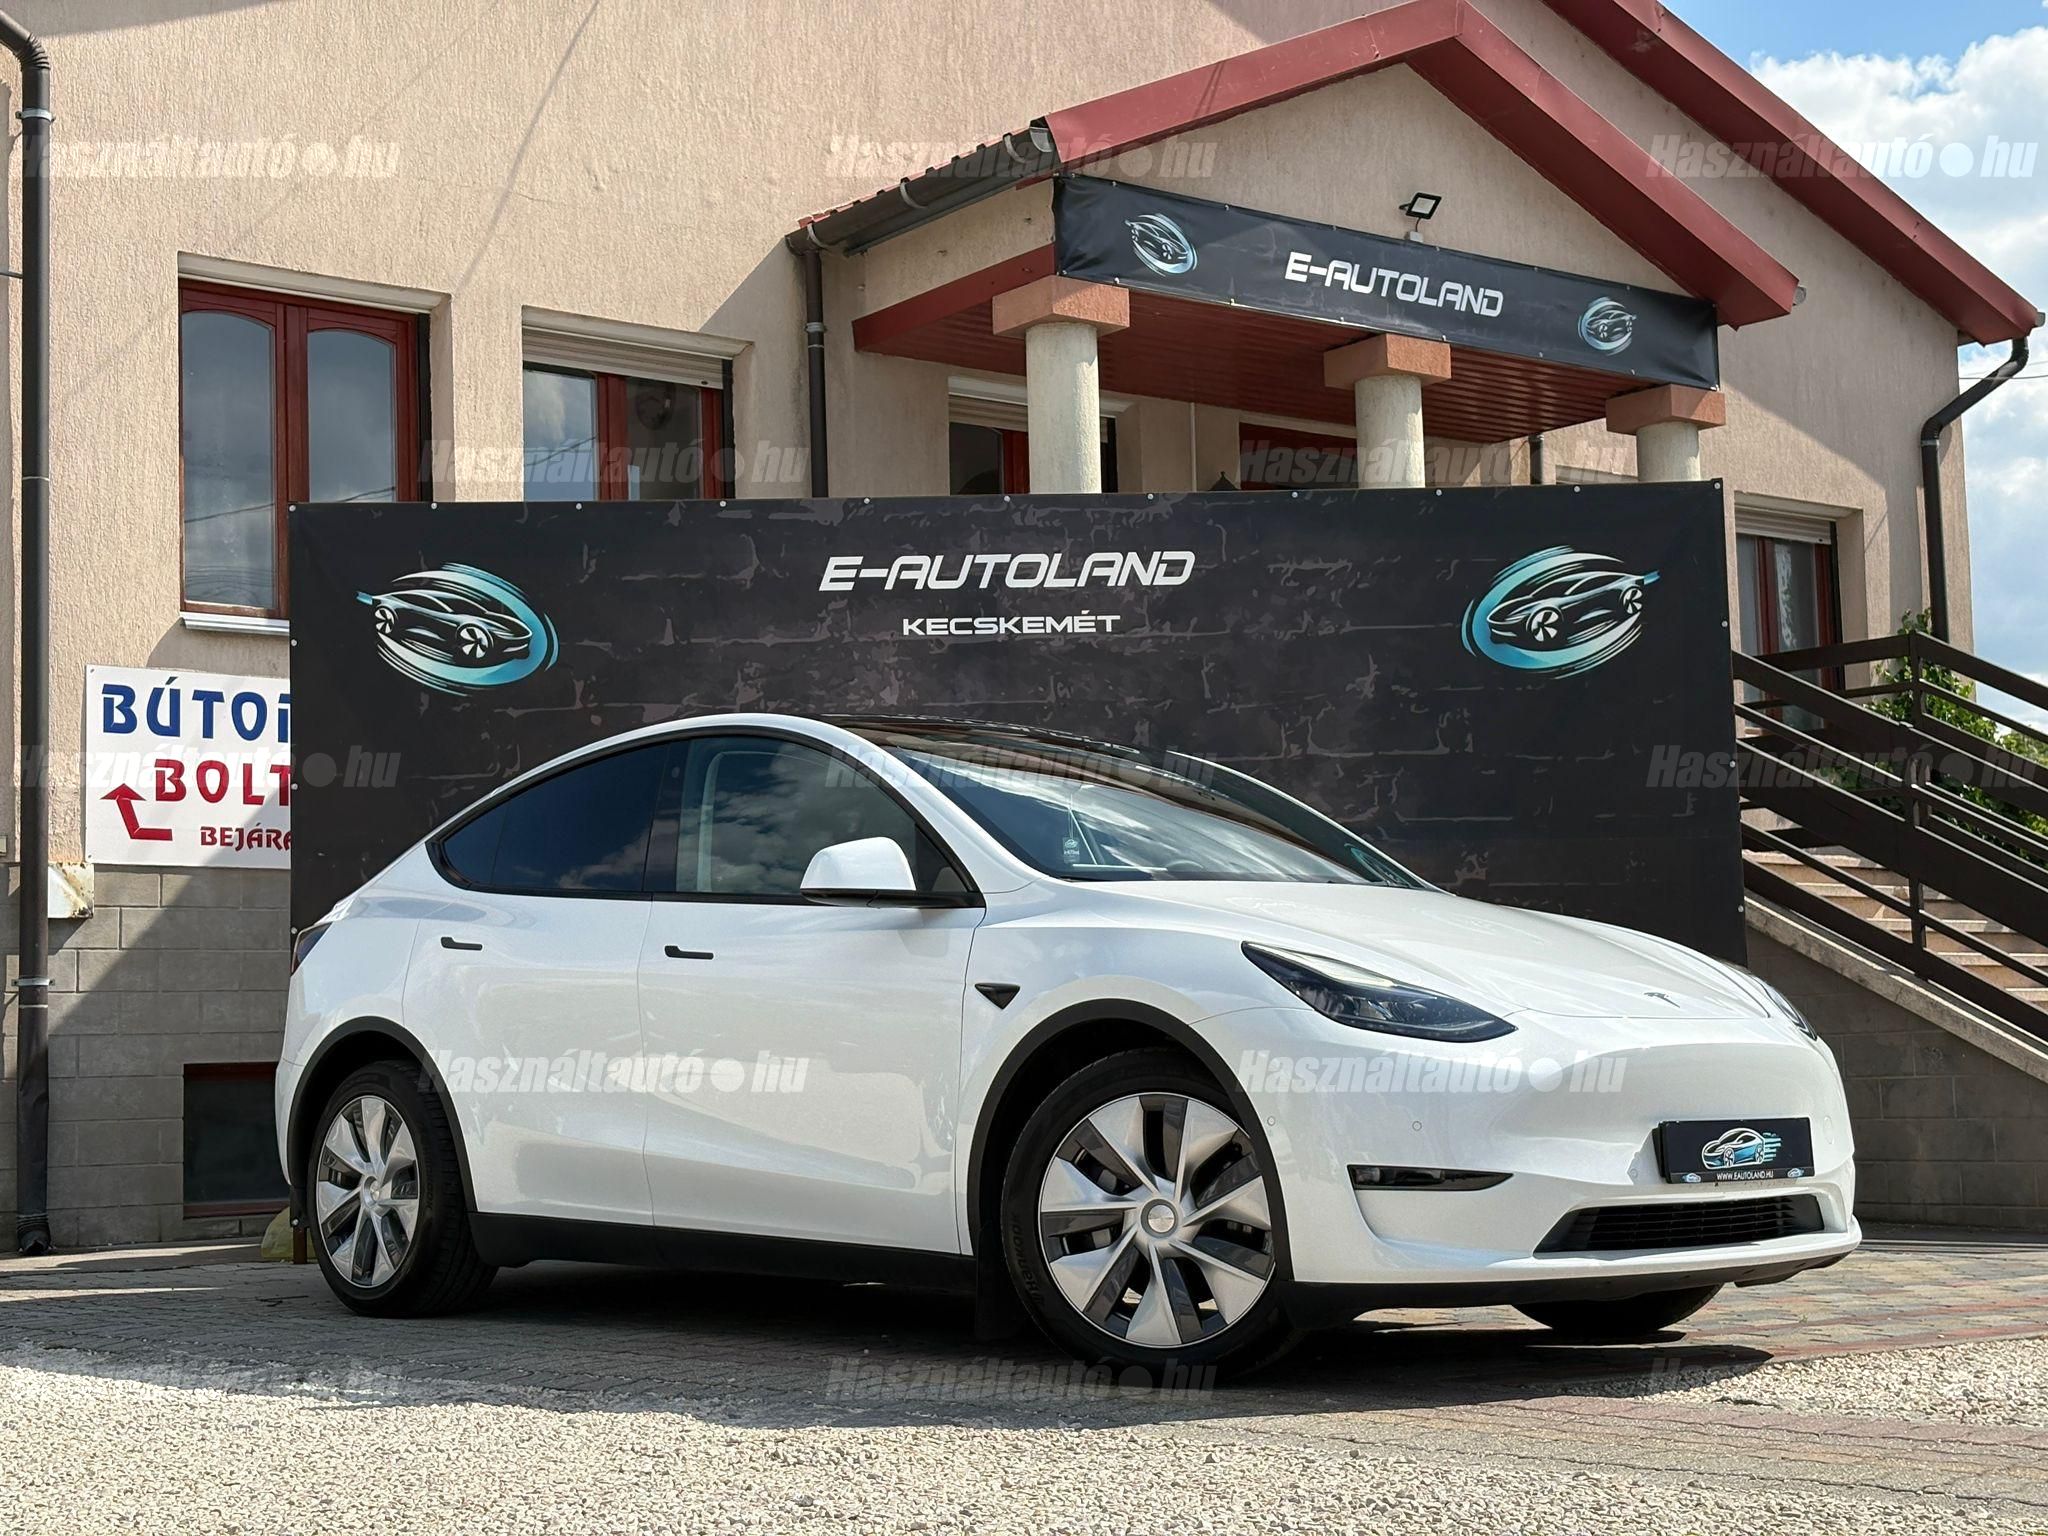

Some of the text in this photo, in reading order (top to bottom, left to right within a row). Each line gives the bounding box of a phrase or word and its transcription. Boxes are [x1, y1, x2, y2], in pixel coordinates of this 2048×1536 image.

[1285, 251, 1504, 318] E-AUTOLAND
[819, 551, 1196, 591] E-AUTOLAND
[903, 610, 1120, 636] KECSKEMÉT
[154, 759, 290, 806] BOLT
[1716, 1170, 1774, 1181] WWW.EAUTOLAND.HU
